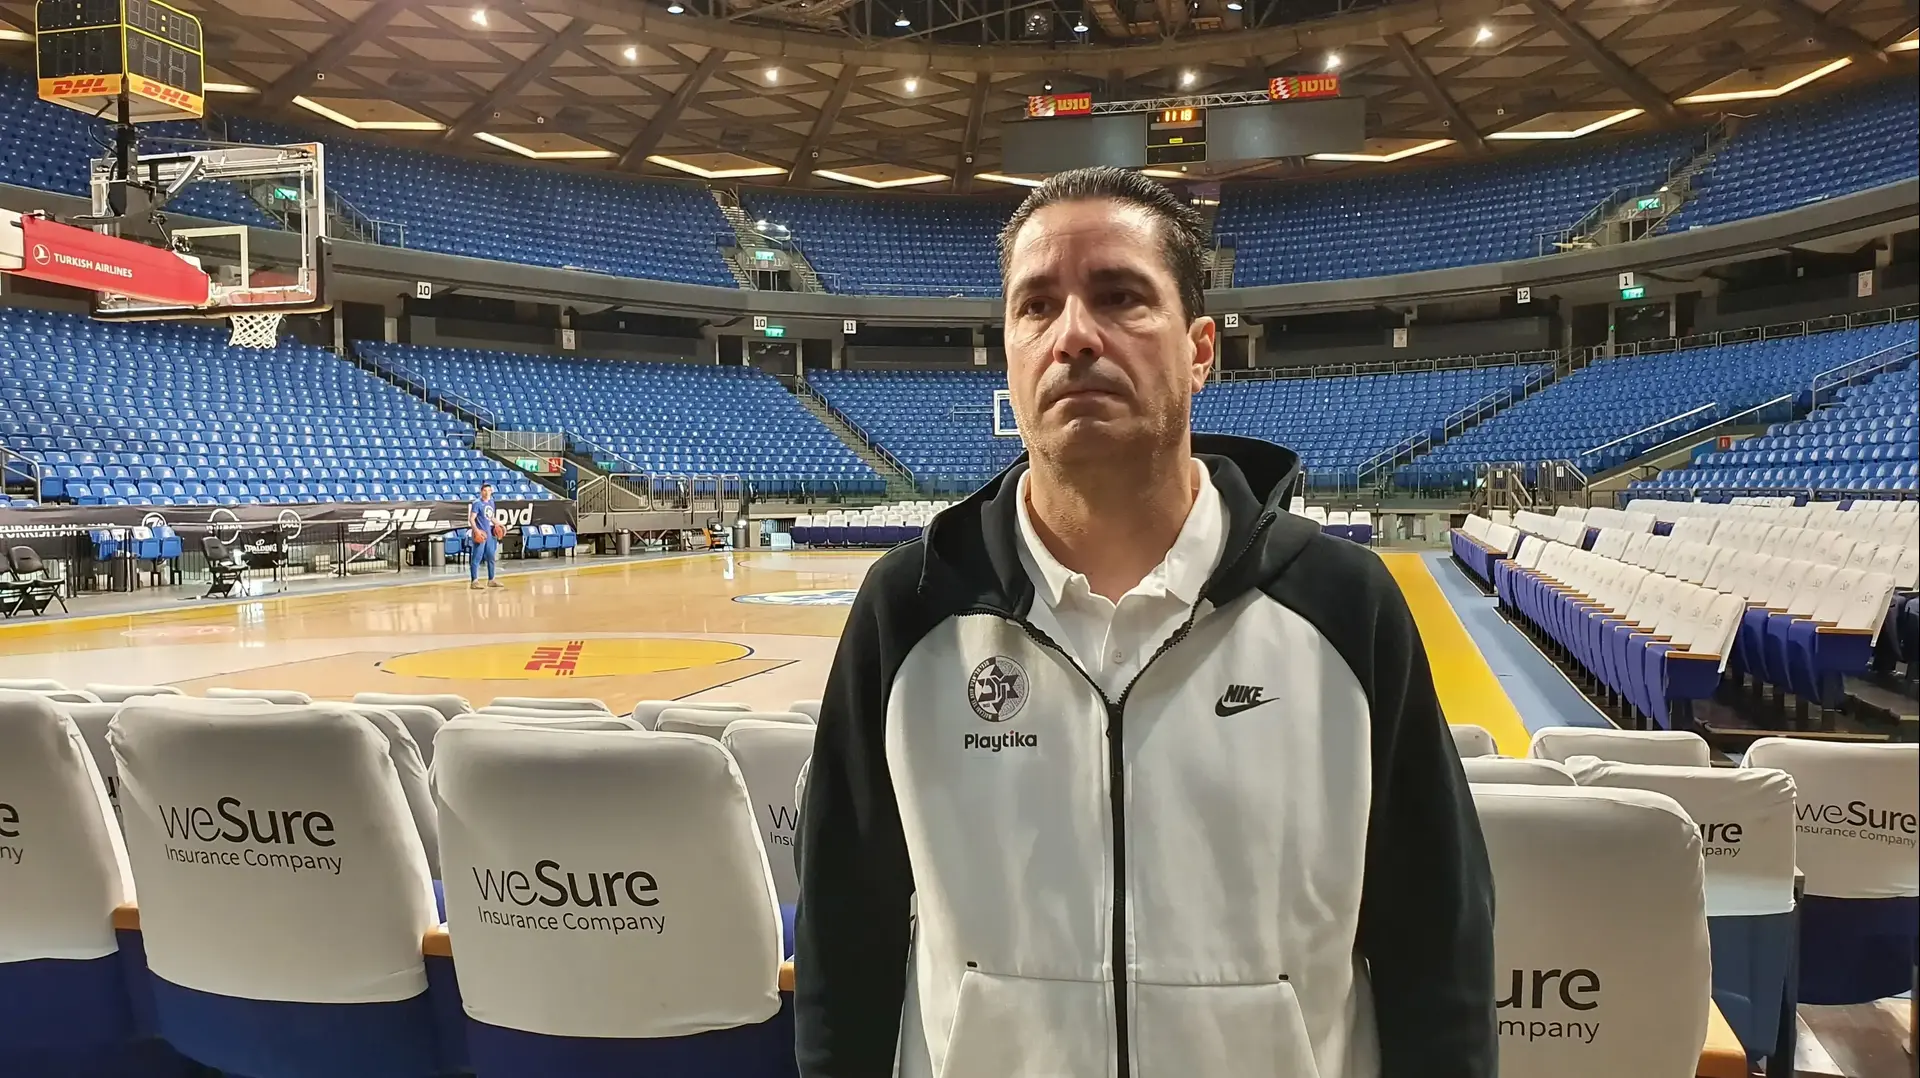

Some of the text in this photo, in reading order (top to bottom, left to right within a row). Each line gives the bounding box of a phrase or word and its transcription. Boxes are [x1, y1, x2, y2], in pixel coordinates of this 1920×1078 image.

[53, 78, 108, 95] DHL
[141, 81, 193, 109] DHL
[1301, 79, 1337, 93] טוטו
[1057, 97, 1090, 111] טוטו
[54, 252, 133, 278] TURKISH AIRLINES
[418, 284, 430, 296] 10
[1623, 276, 1629, 286] 1
[1518, 290, 1529, 301] 12
[755, 318, 766, 328] 10
[846, 322, 854, 331] 11
[1226, 316, 1236, 325] 12
[362, 508, 438, 532] DHL
[1223, 684, 1264, 703] NIKE
[964, 730, 1037, 752] Playtika
[159, 796, 336, 847] weSure
[1796, 801, 1917, 834] weSure
[1796, 824, 1917, 849] nsurance Company
[164, 844, 342, 875] Insurance Company
[1702, 846, 1741, 858] pany
[472, 859, 660, 908] weSure
[477, 905, 666, 936] Insurance Company
[1496, 969, 1600, 1010] ure
[1499, 1020, 1600, 1044] mpany
